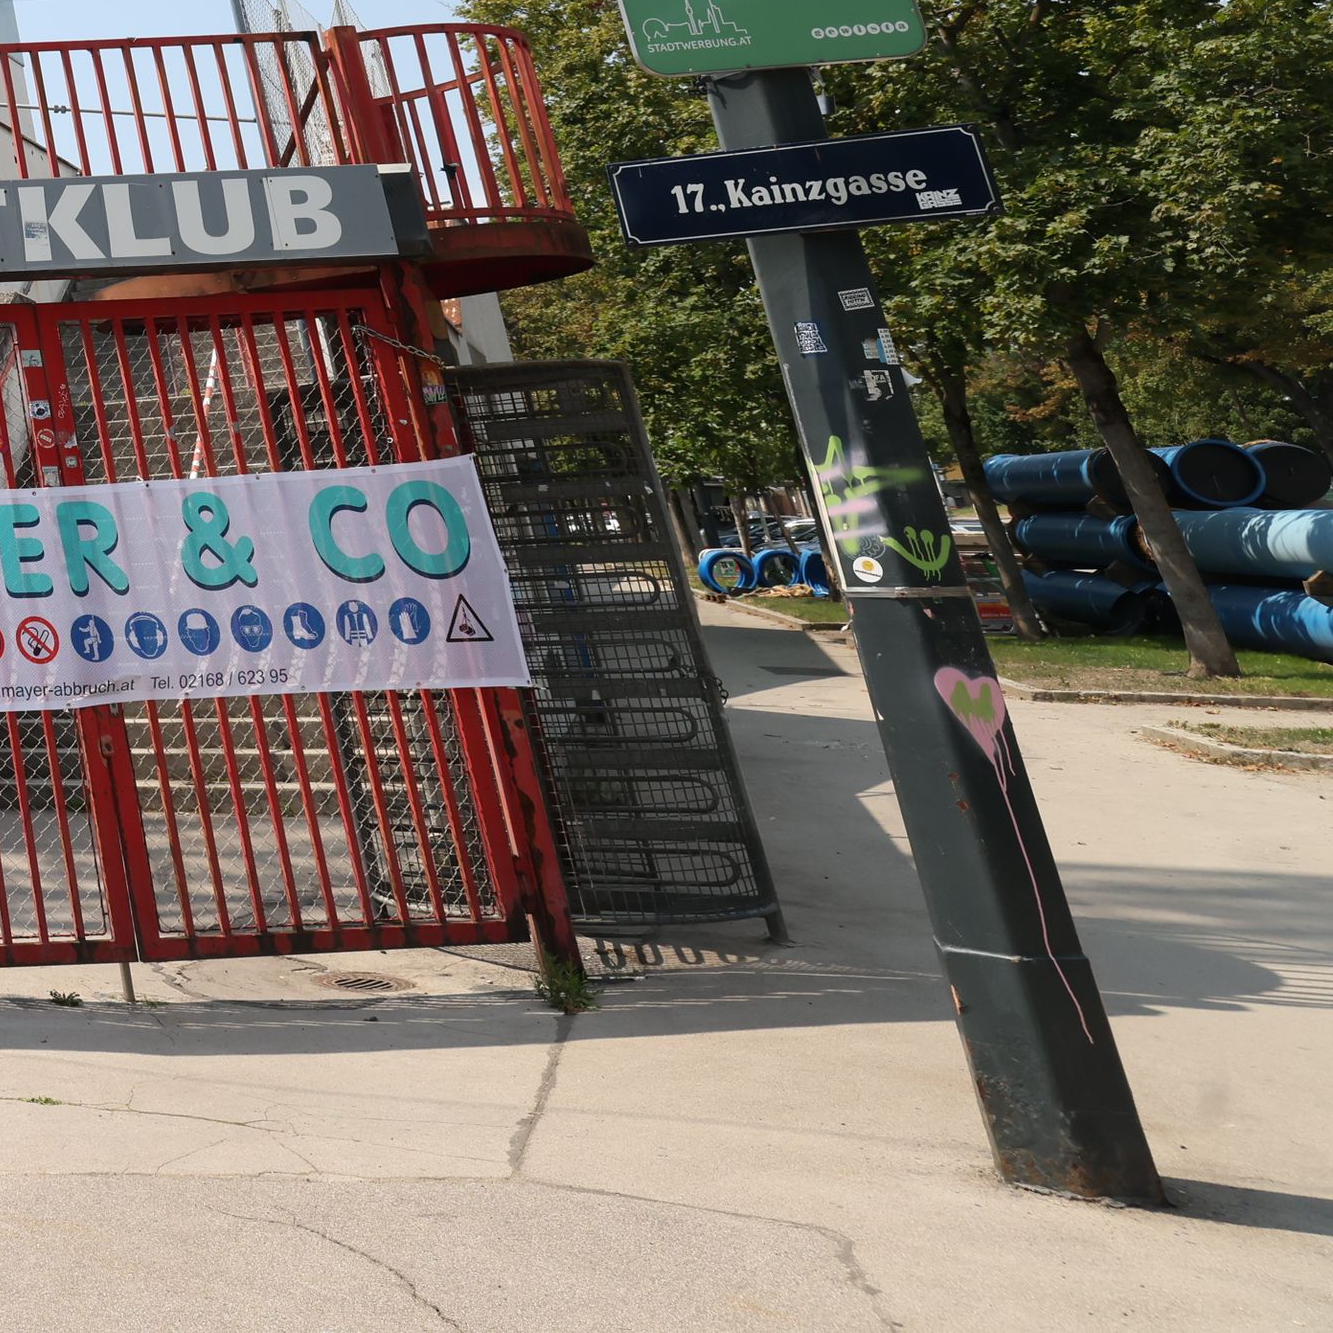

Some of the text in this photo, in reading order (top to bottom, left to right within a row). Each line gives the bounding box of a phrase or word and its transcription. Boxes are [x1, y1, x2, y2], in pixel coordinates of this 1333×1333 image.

[647, 36, 752, 54] STADTWERBUNG.AT
[724, 169, 928, 210] Kainzgasse
[182, 491, 258, 591] &
[308, 479, 473, 584] CO
[150, 676, 174, 690] Tel.
[179, 672, 224, 689] 02168
[237, 669, 265, 685] 623
[269, 668, 289, 684] 95
